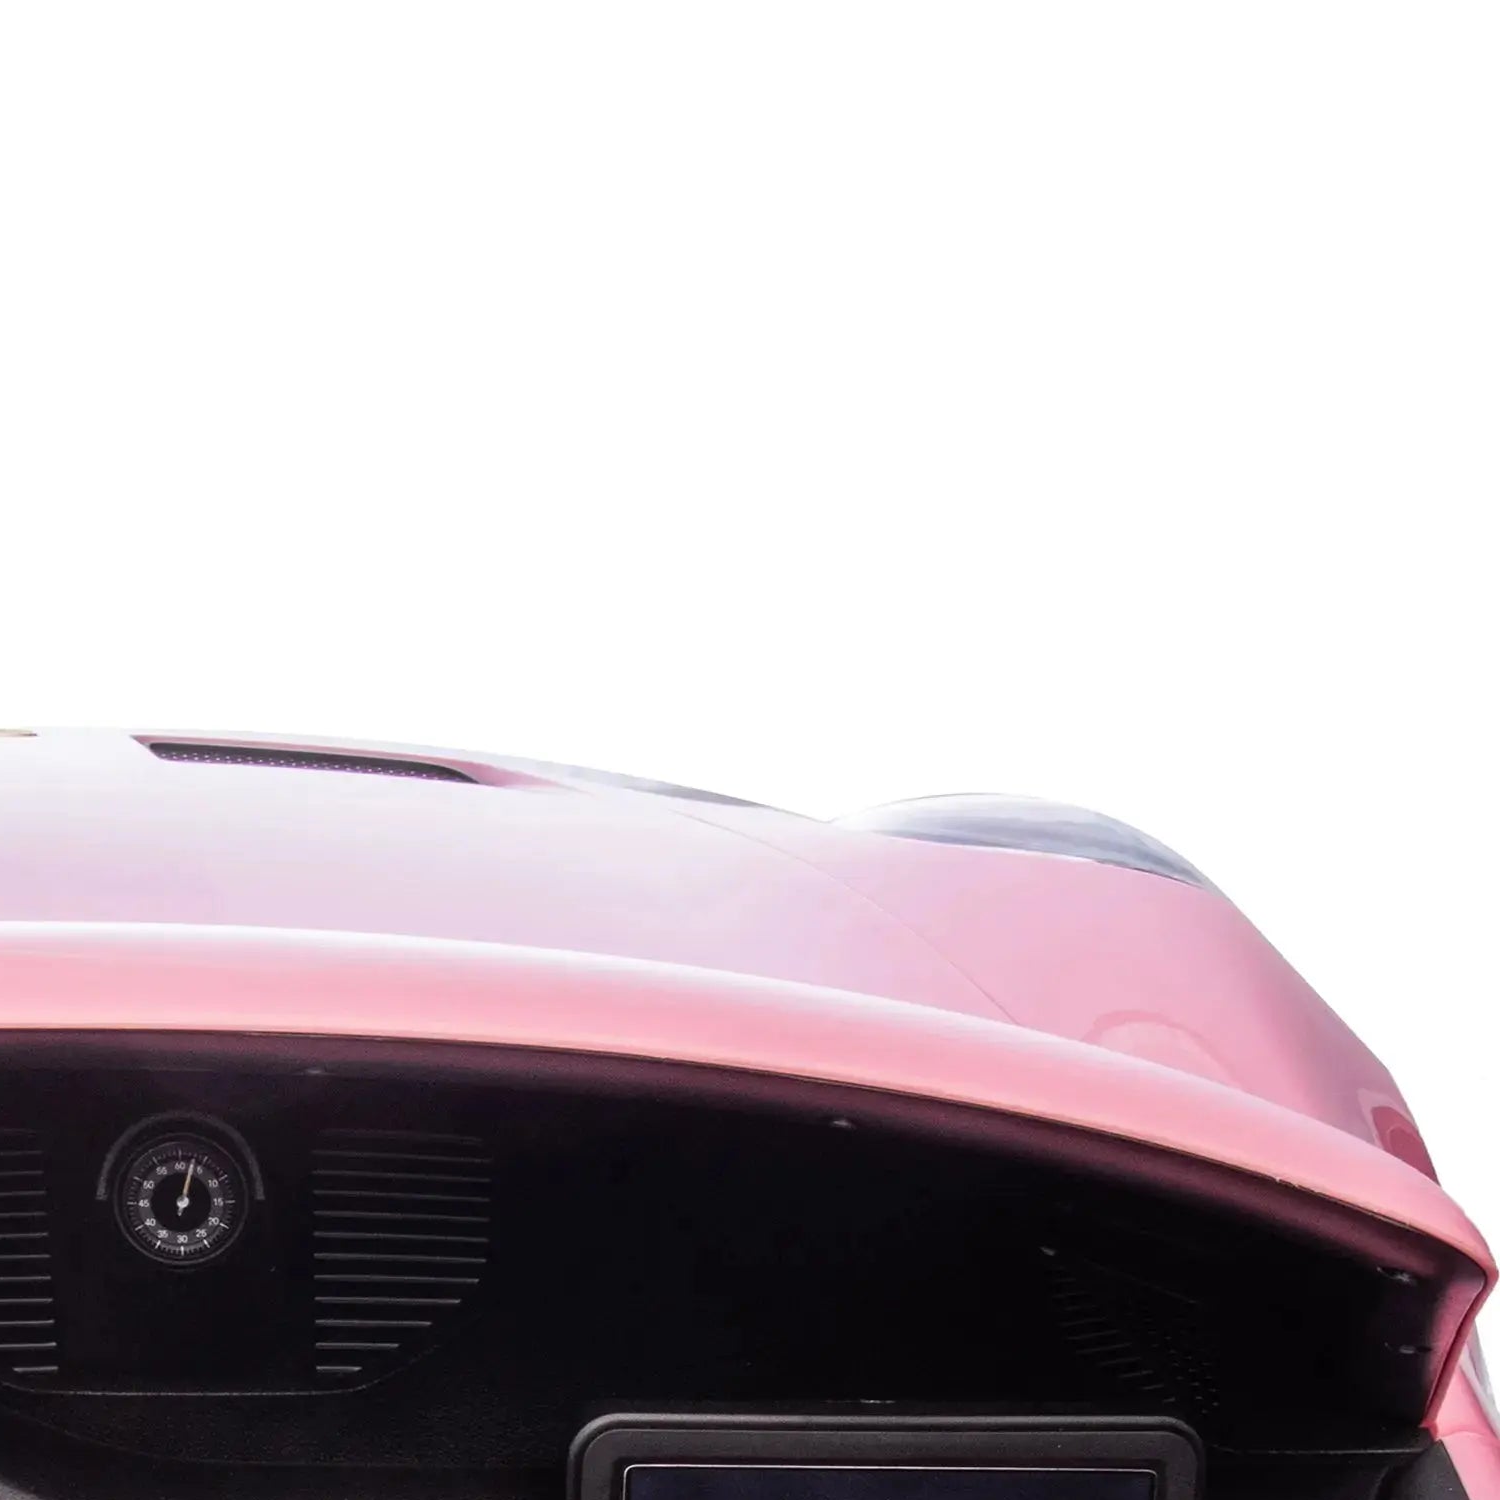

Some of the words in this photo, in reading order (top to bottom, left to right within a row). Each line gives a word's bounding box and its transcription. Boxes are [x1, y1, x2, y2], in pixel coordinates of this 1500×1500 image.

[208, 1179, 218, 1188] 10
[145, 1218, 156, 1227] 40
[208, 1217, 220, 1225] 20
[157, 1230, 168, 1239] 35
[177, 1235, 188, 1244] 30
